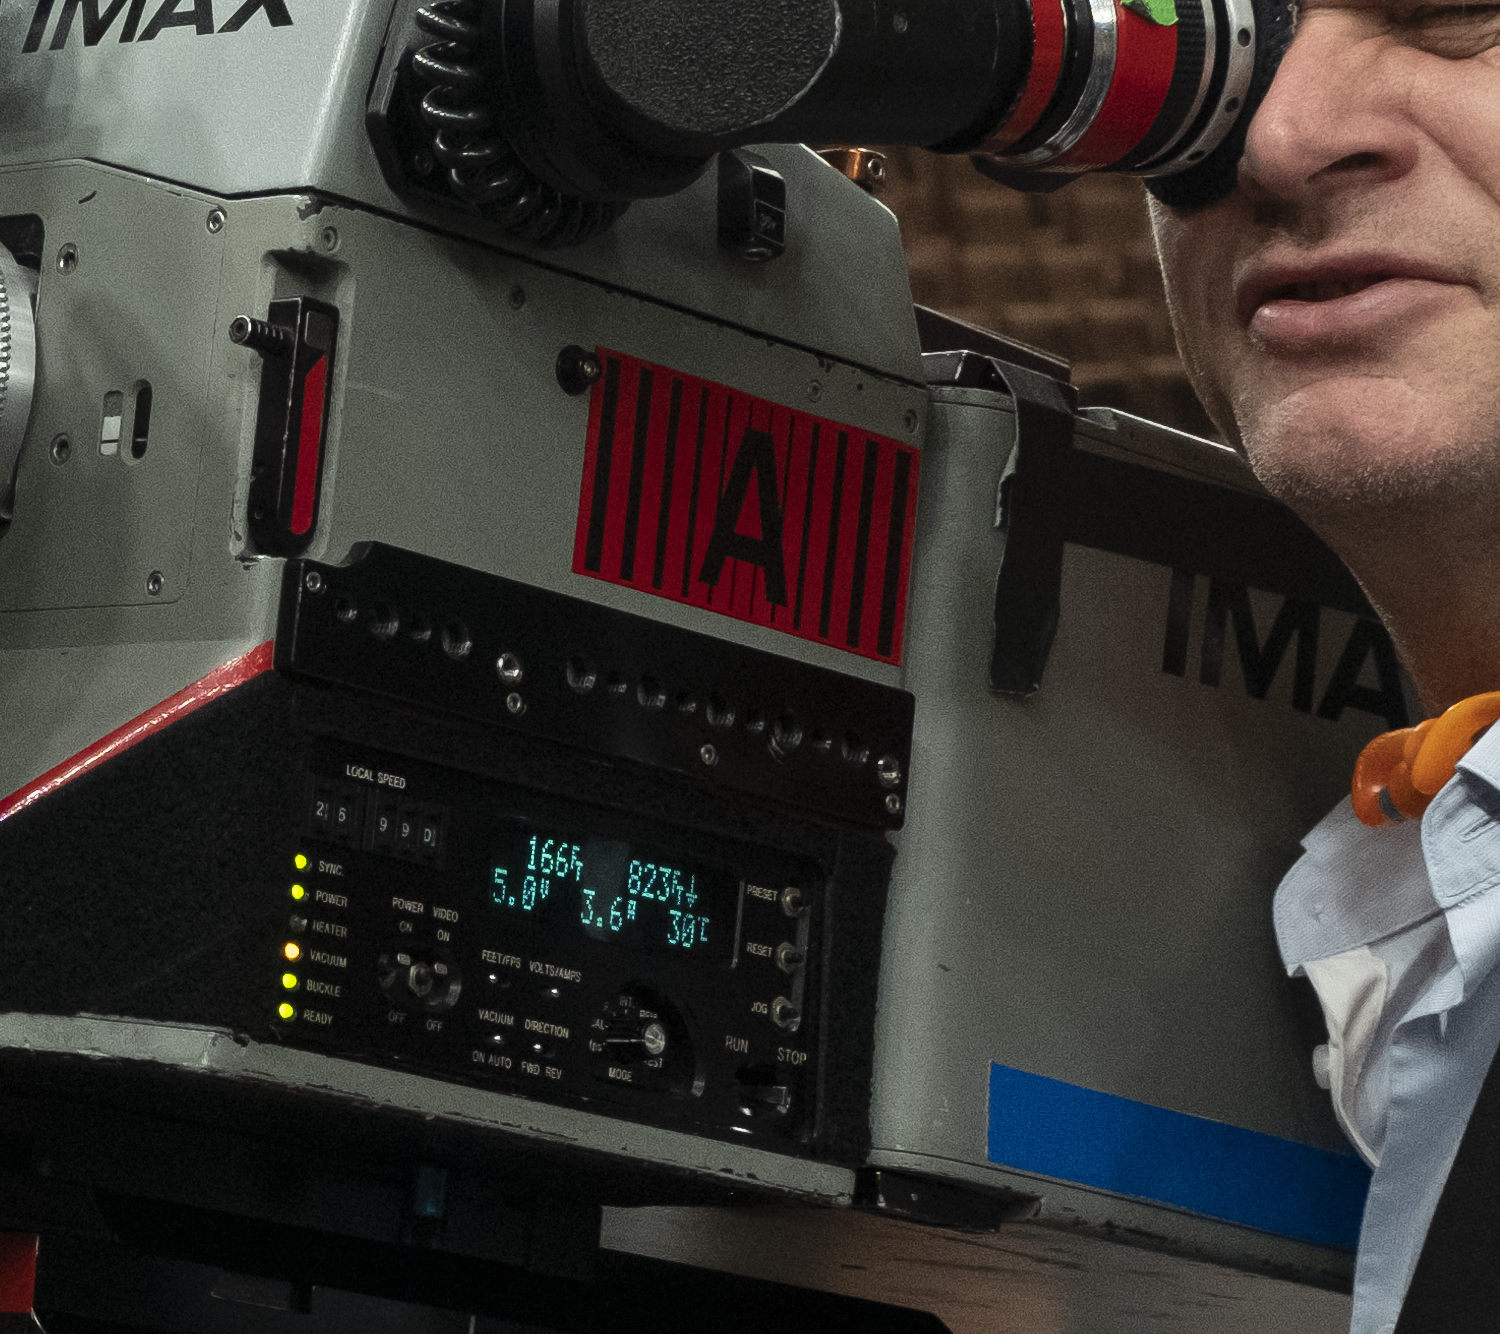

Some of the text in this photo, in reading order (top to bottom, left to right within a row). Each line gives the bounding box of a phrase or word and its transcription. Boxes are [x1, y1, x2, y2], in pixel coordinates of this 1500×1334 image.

[697, 427, 789, 606] A
[1162, 567, 1411, 730] IMA
[346, 764, 406, 789] LOCAL SPEED
[315, 889, 348, 908] POWER
[746, 883, 778, 902] PRESET
[392, 896, 459, 923] POWER VIDEO
[312, 919, 348, 938] HEATER
[398, 920, 413, 933] ON
[437, 928, 451, 942] ON
[310, 948, 348, 968] VACUUM
[746, 941, 773, 958] RESET
[306, 978, 342, 998] BUCKLE
[303, 1008, 333, 1025] READY
[750, 1000, 768, 1016] JOG
[477, 1007, 570, 1039] VACUUM DIRECTION
[725, 1034, 749, 1054] RUN
[472, 1050, 513, 1070] ON AUTO
[777, 1046, 808, 1065] STOP
[545, 1066, 563, 1080] REV
[608, 1066, 633, 1082] MODE
